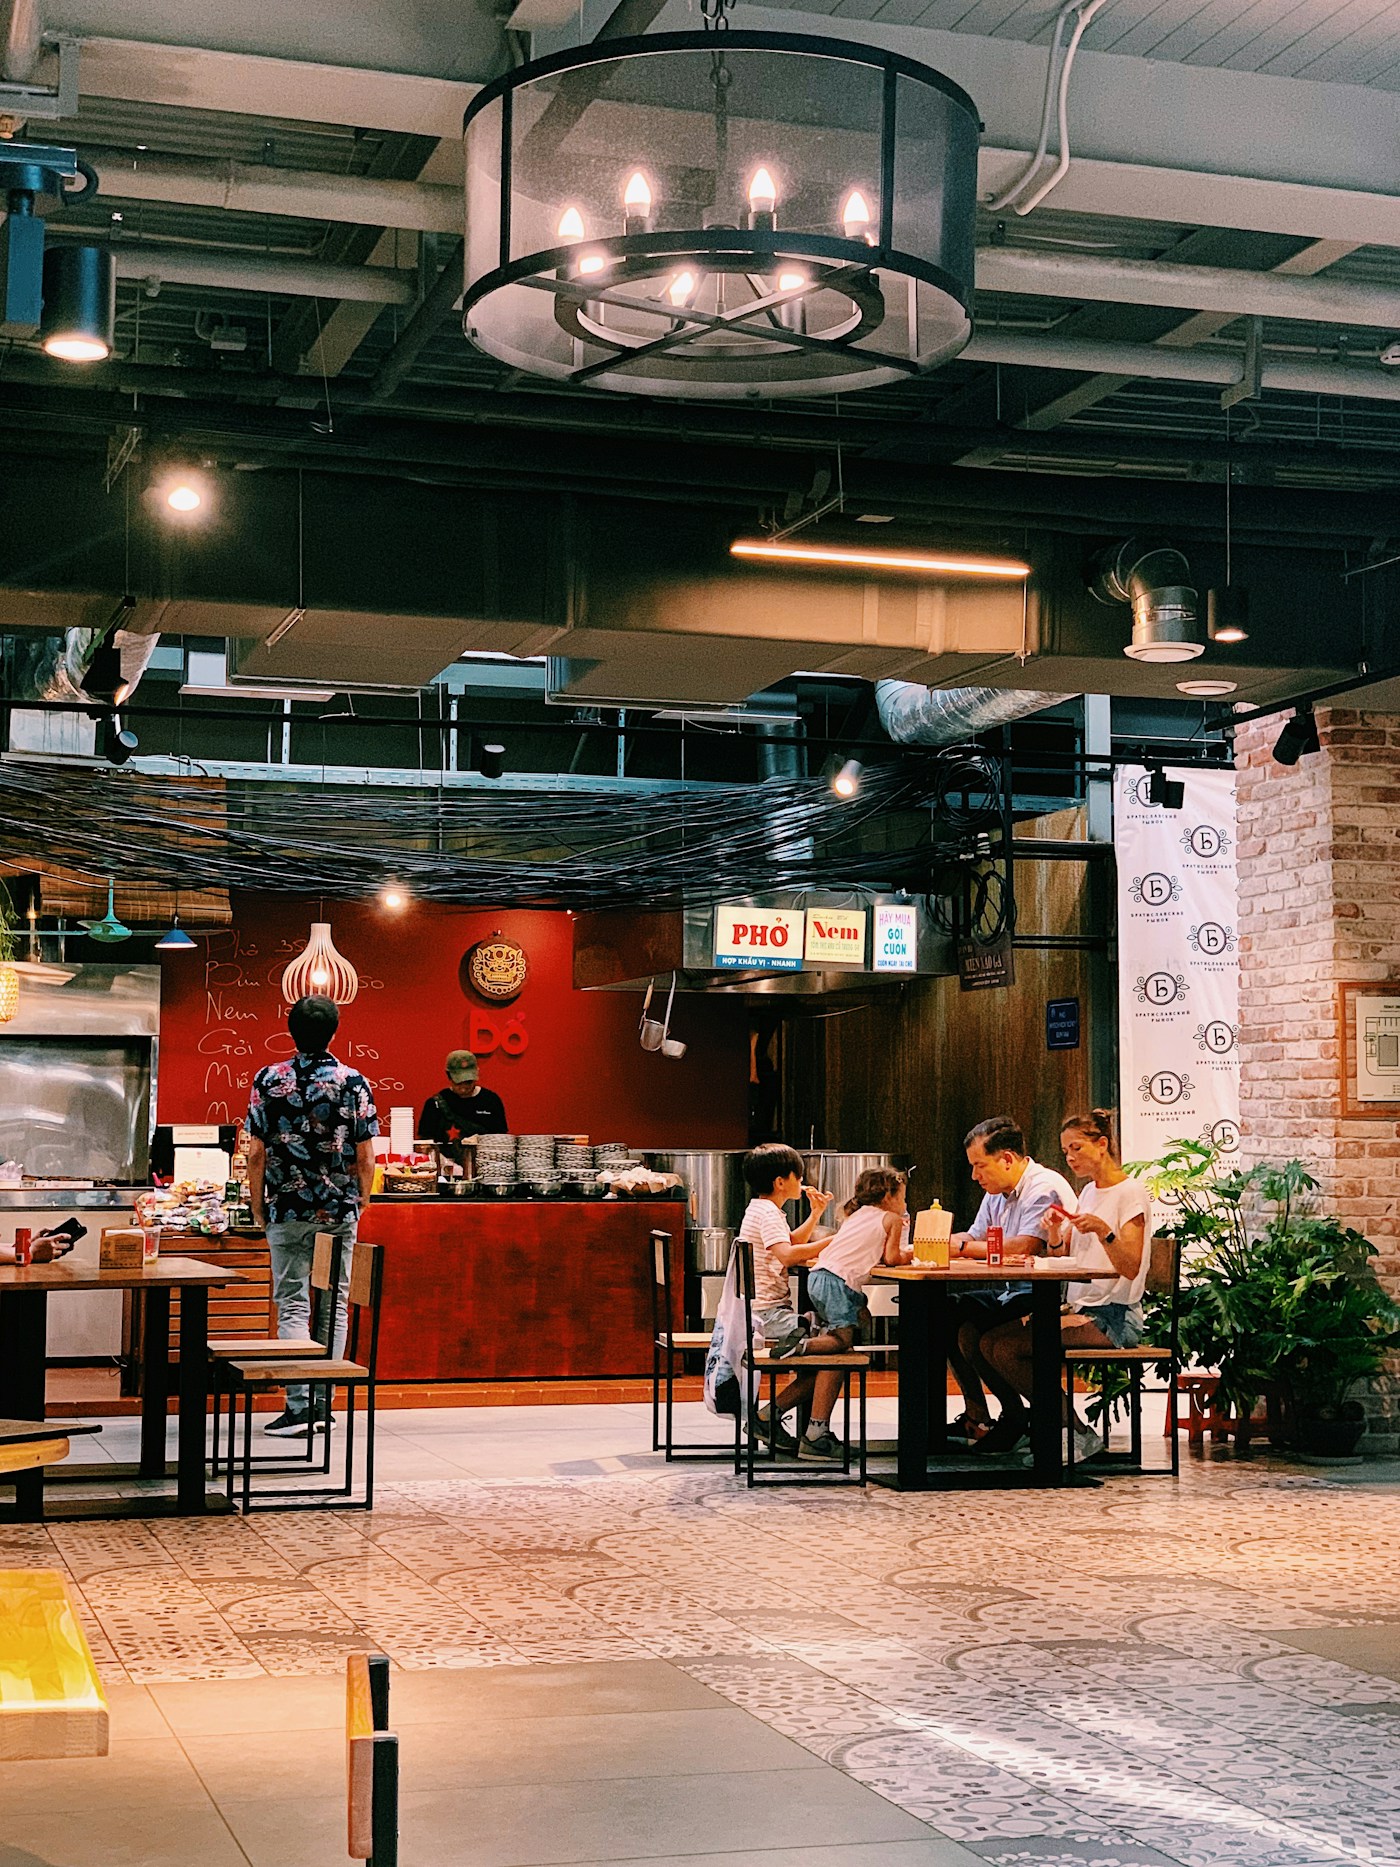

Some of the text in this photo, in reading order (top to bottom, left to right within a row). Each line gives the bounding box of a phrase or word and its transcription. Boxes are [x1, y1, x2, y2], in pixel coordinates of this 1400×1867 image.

[1200, 832, 1213, 850] Б
[1149, 880, 1163, 898] Б
[732, 917, 789, 947] PHỞ
[812, 921, 858, 940] Nem
[1205, 929, 1219, 947] Б
[1153, 979, 1168, 998] Б
[206, 991, 258, 1024] Nem
[1212, 1028, 1226, 1046] Б
[1159, 1078, 1174, 1097] Б
